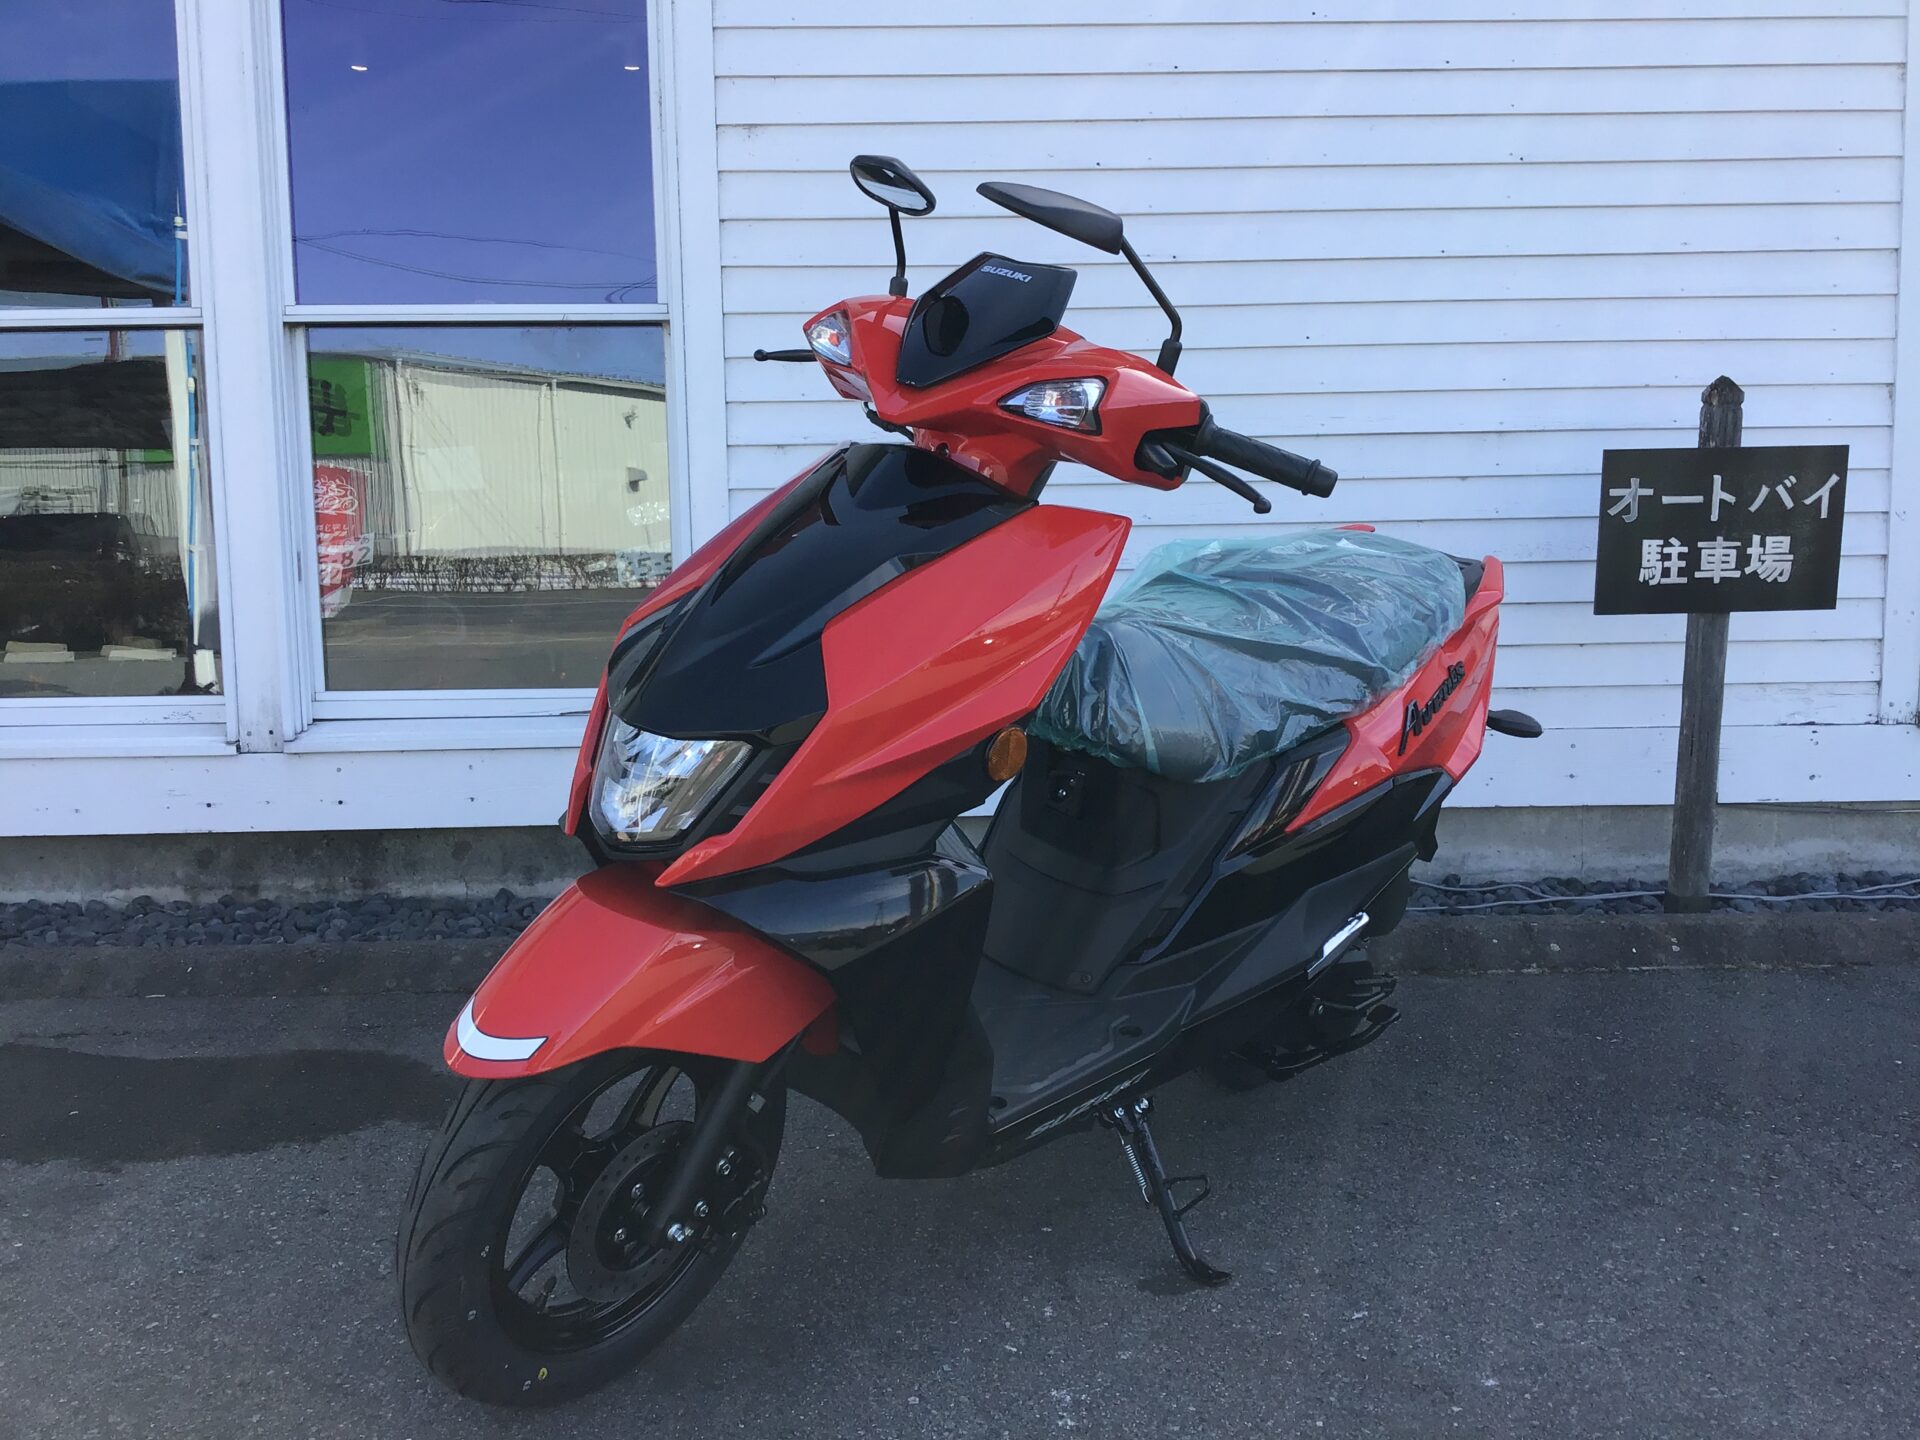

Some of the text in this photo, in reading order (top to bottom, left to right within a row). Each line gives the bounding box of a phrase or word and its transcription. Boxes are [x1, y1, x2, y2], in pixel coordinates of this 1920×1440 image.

[980, 265, 1032, 283] SUZUKI
[1607, 473, 1840, 523] オートバイ
[1638, 534, 1794, 586] 駐車場
